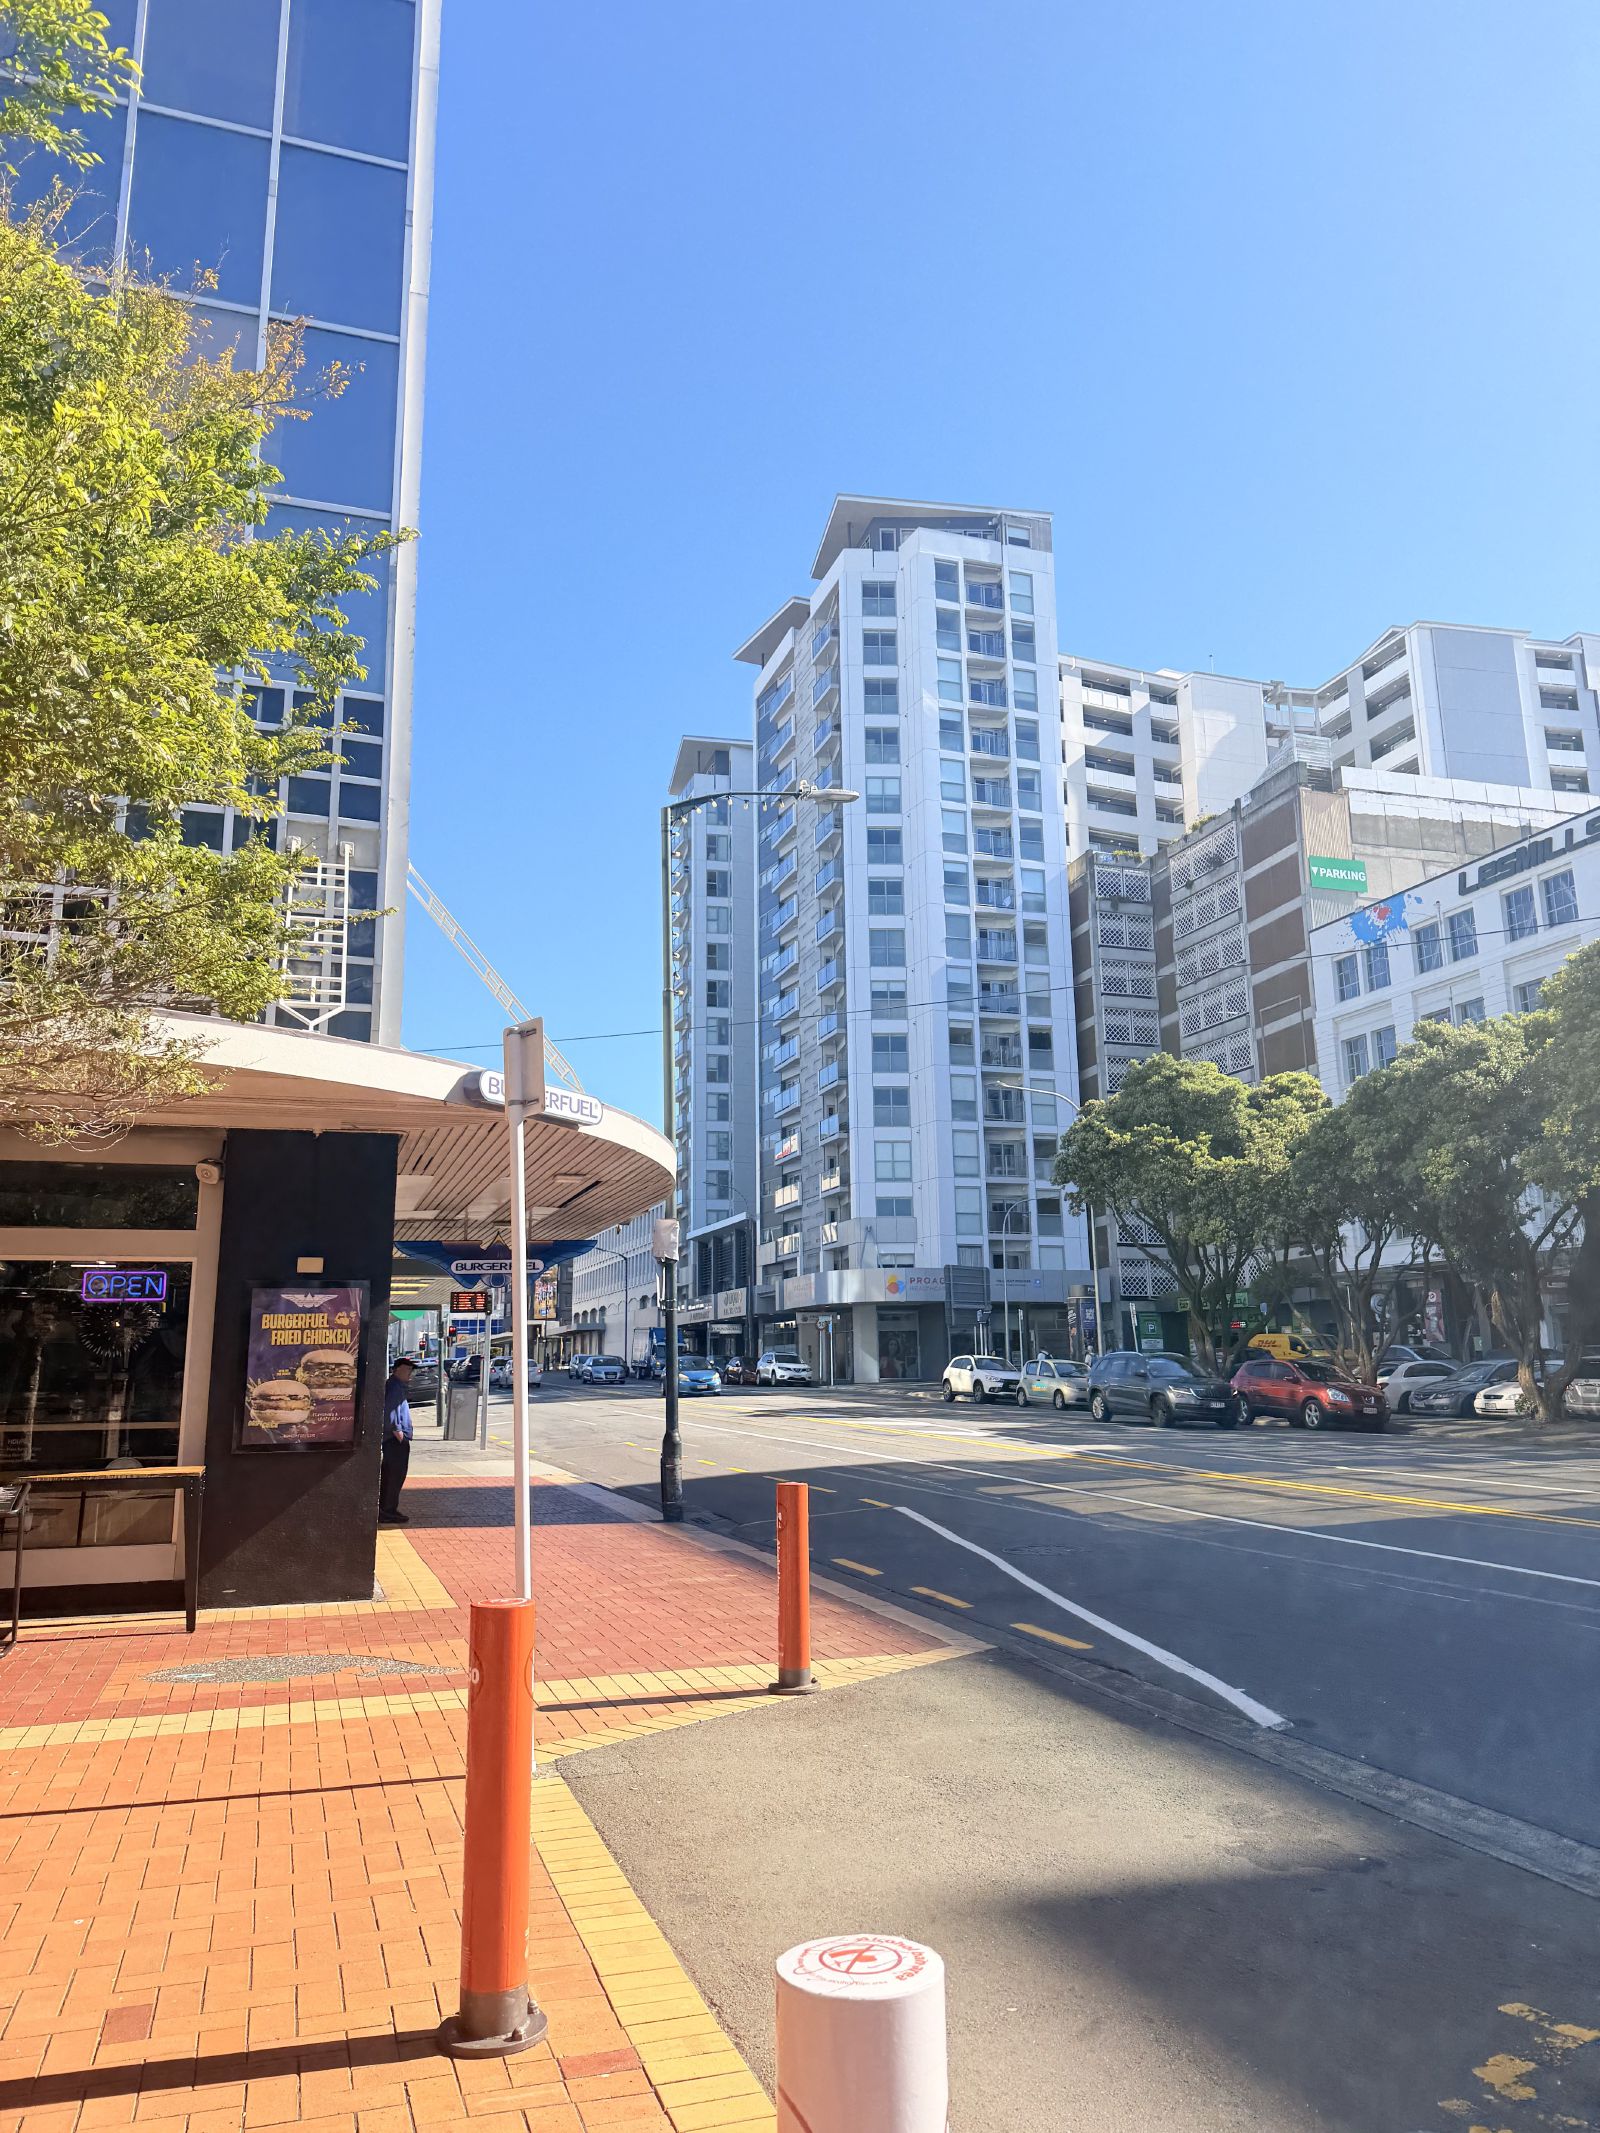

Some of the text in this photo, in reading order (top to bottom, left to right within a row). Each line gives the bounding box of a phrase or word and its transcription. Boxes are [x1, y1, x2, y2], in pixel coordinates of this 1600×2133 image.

[1319, 866, 1367, 882] PARKING
[488, 1076, 598, 1119] BRFUEL
[455, 1261, 540, 1272] BURGEREL
[87, 1274, 163, 1297] OPEN
[261, 1312, 330, 1329] BURGERFUEL
[271, 1328, 351, 1346] FRIED CHICKEN
